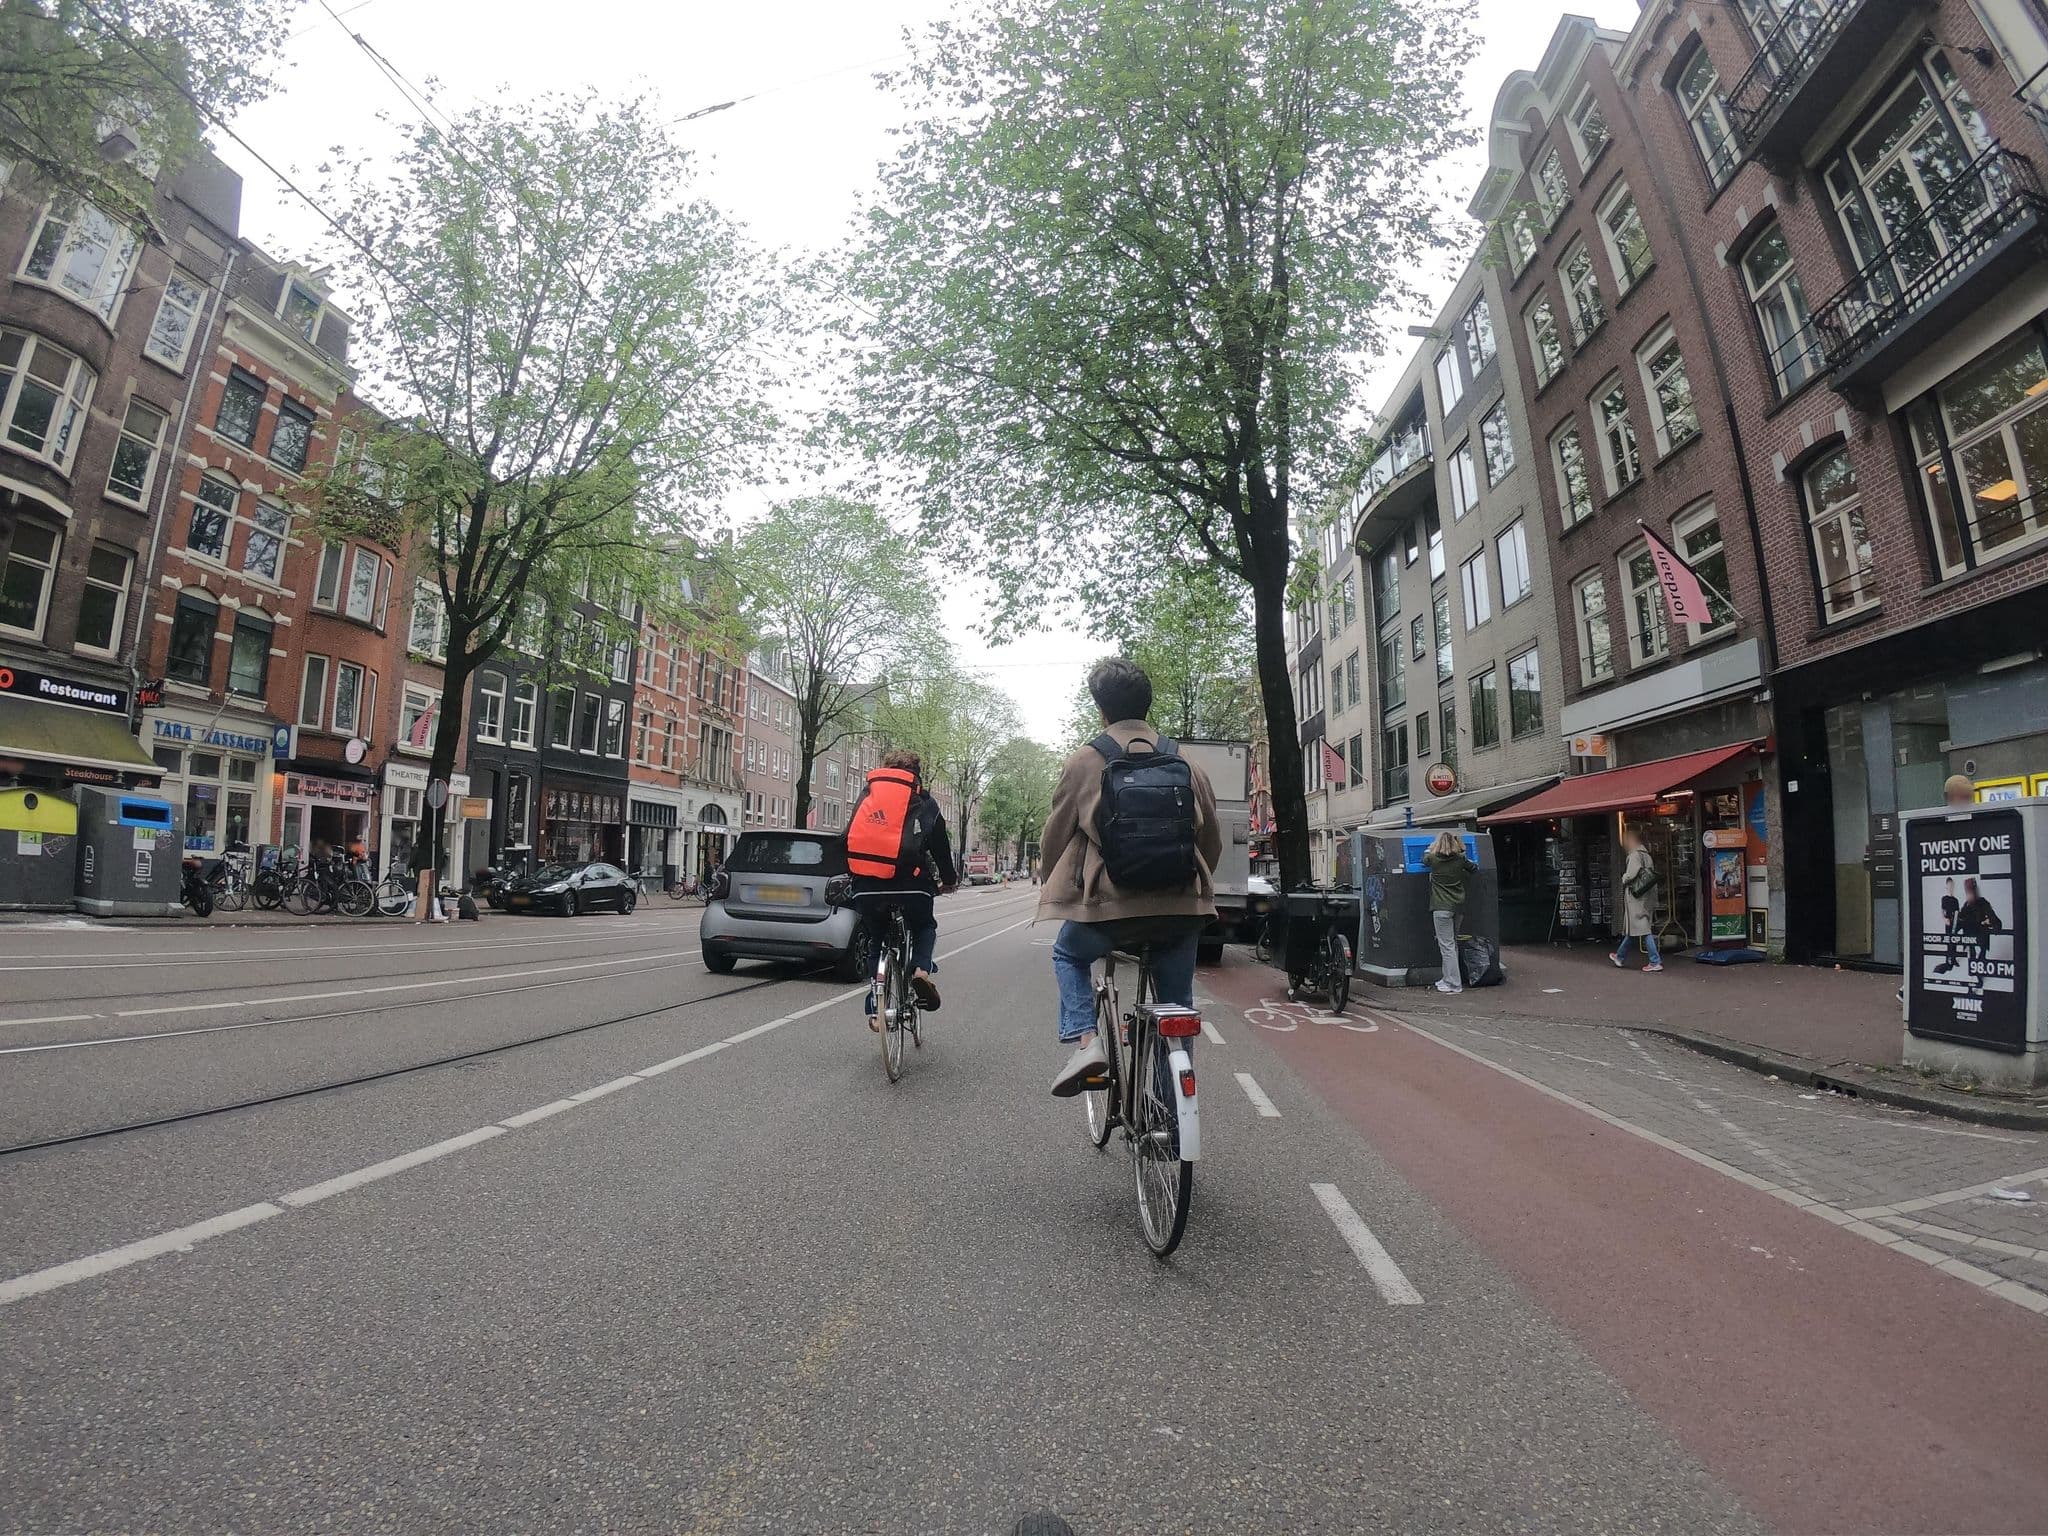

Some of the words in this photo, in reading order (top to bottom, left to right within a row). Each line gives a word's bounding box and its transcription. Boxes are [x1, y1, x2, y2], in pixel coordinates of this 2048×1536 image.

[39, 678, 118, 706] Restaurant
[391, 769, 423, 781] THEATRE
[1920, 838, 1976, 856] TWENTY
[1979, 835, 2010, 851] ONE
[1921, 857, 1966, 873] PILOTS
[1923, 935, 1942, 944] HOOR
[1970, 961, 1994, 975] 98.0
[1997, 963, 2014, 977] FM
[1952, 997, 1983, 1013] KINK
